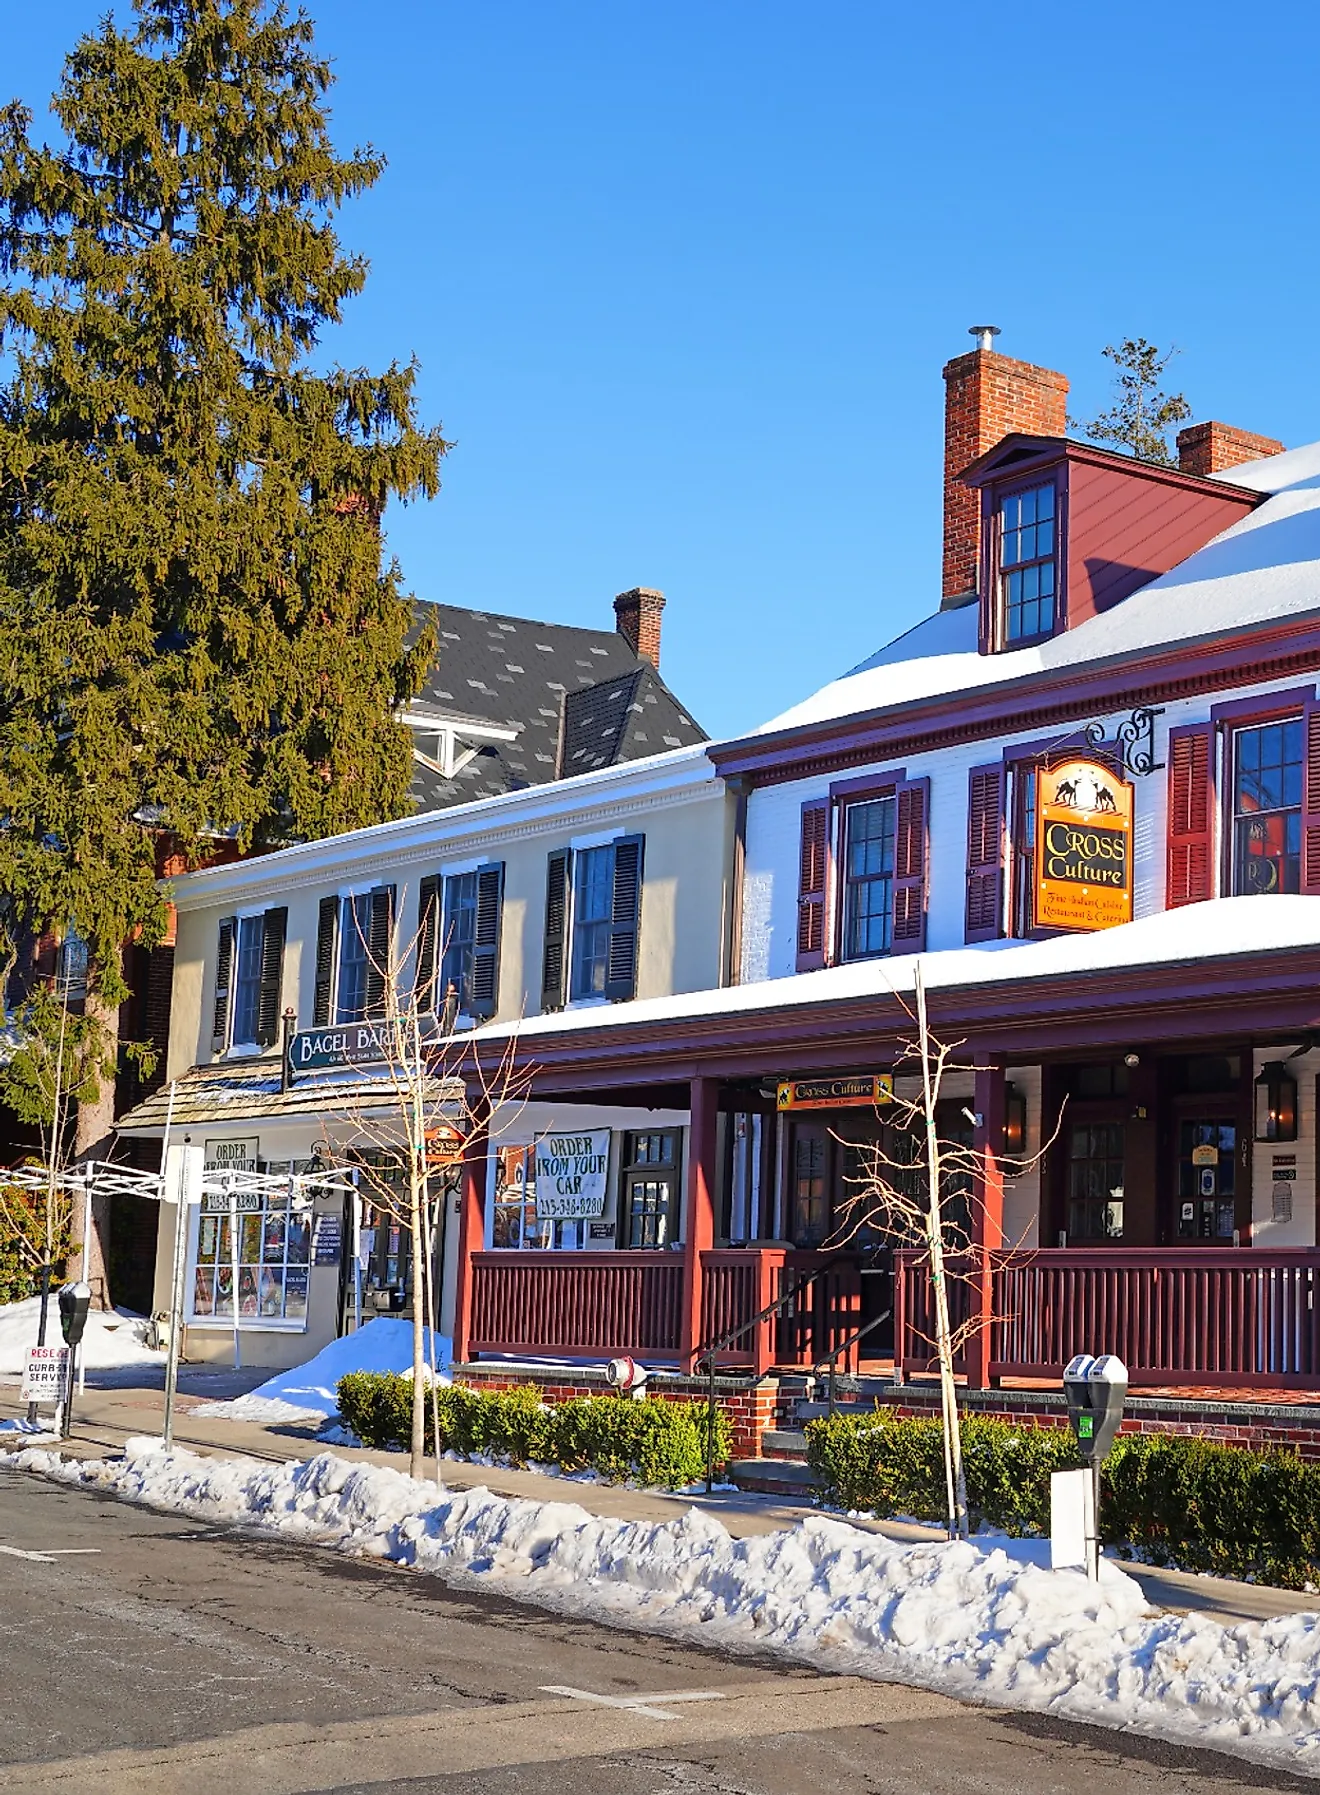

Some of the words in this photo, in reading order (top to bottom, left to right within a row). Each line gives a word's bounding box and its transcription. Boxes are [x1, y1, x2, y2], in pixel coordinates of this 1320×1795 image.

[1047, 856, 1122, 884] Culture
[300, 1033, 351, 1062] BAGEL
[831, 1081, 873, 1096] Culture
[216, 1143, 247, 1160] ORDER
[549, 1136, 593, 1157] ORDER
[574, 1154, 607, 1175] YOUR
[556, 1175, 583, 1195] CAR
